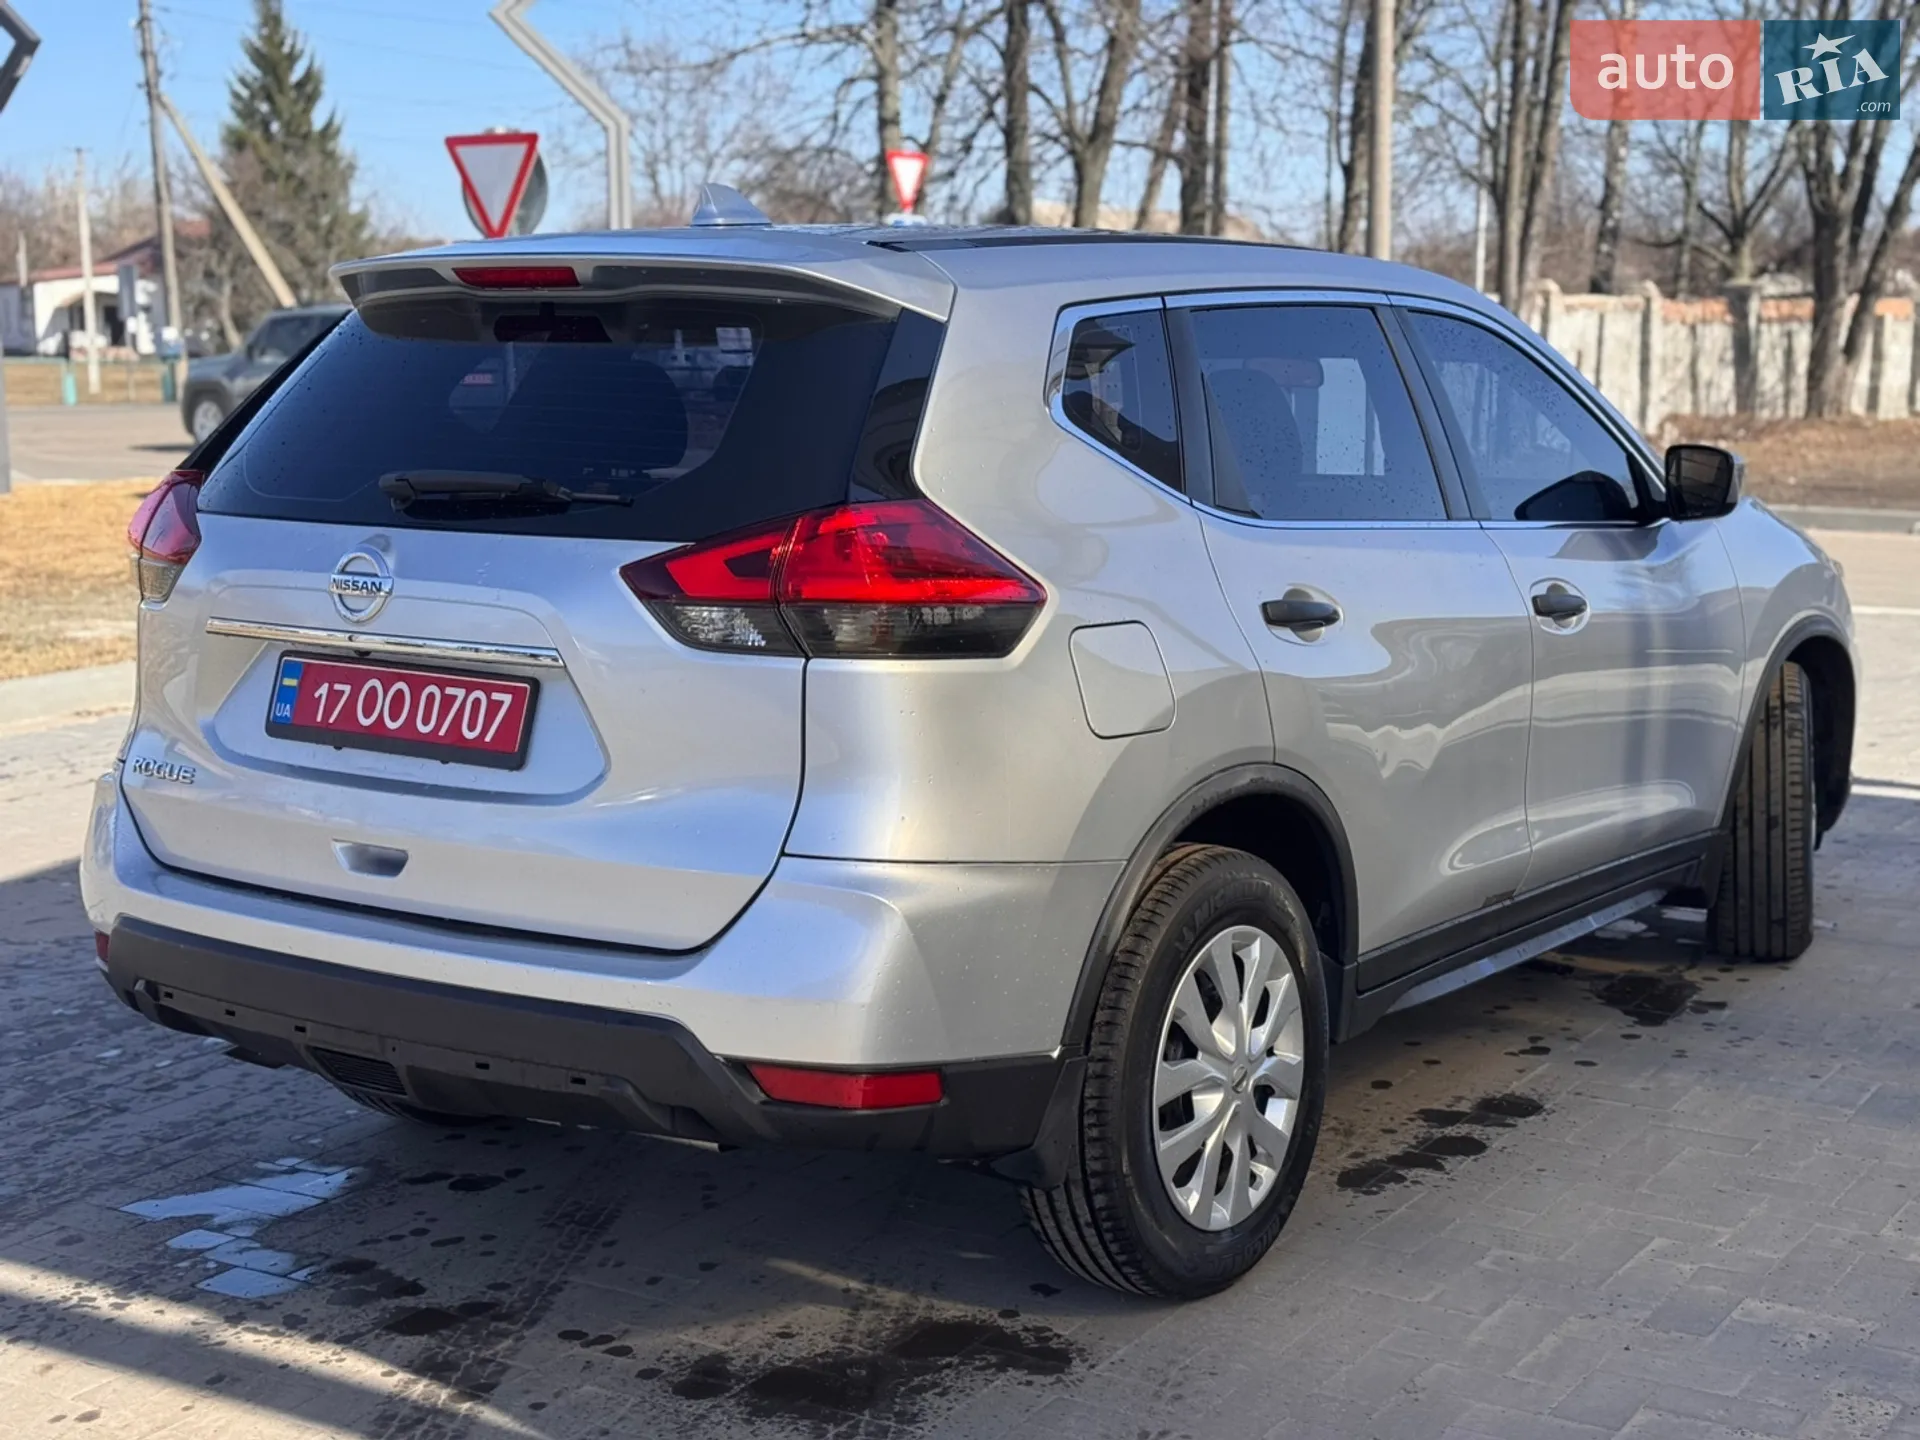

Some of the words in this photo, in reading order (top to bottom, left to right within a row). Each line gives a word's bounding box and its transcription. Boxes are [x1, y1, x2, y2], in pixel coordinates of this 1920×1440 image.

[331, 577, 383, 593] NISSAN
[275, 702, 291, 718] UA
[132, 756, 196, 785] ROGUE
